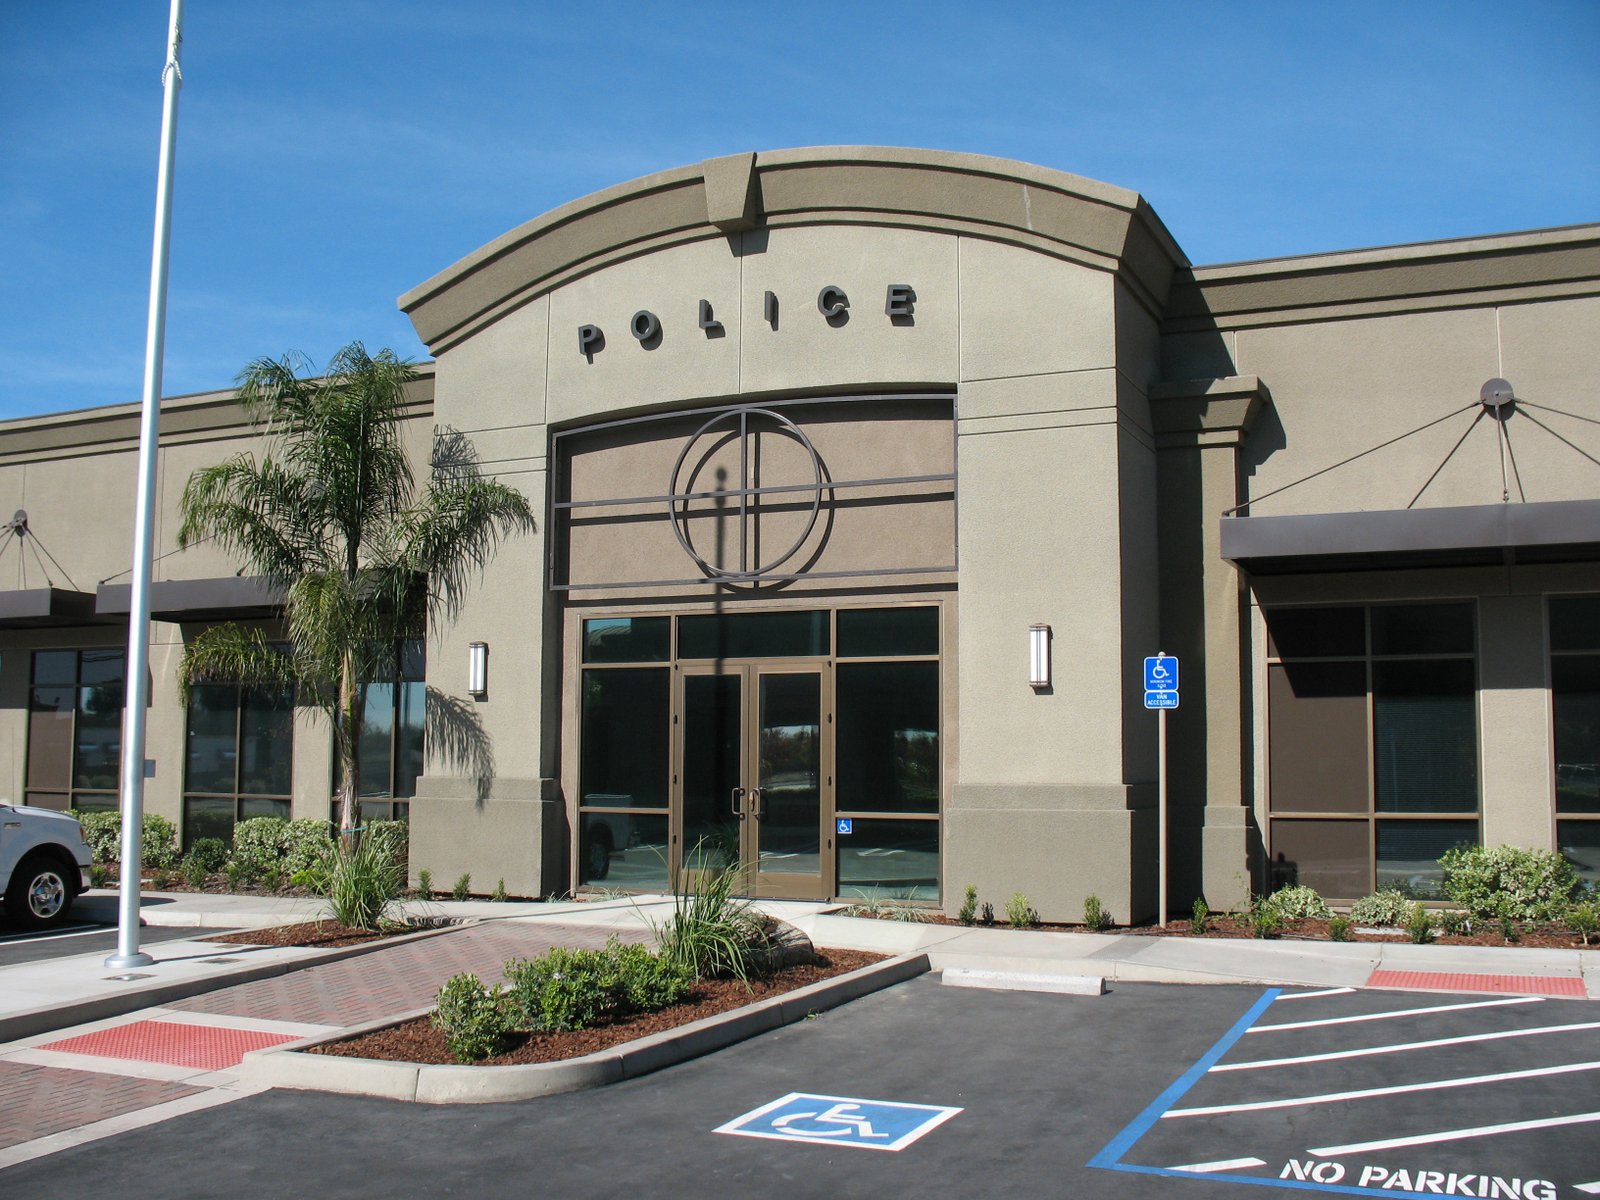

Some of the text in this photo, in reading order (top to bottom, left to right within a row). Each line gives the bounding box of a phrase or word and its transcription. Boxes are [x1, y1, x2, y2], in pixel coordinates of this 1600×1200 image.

[578, 284, 914, 356] POLICE
[1279, 1159, 1557, 1200] NO PARKING
